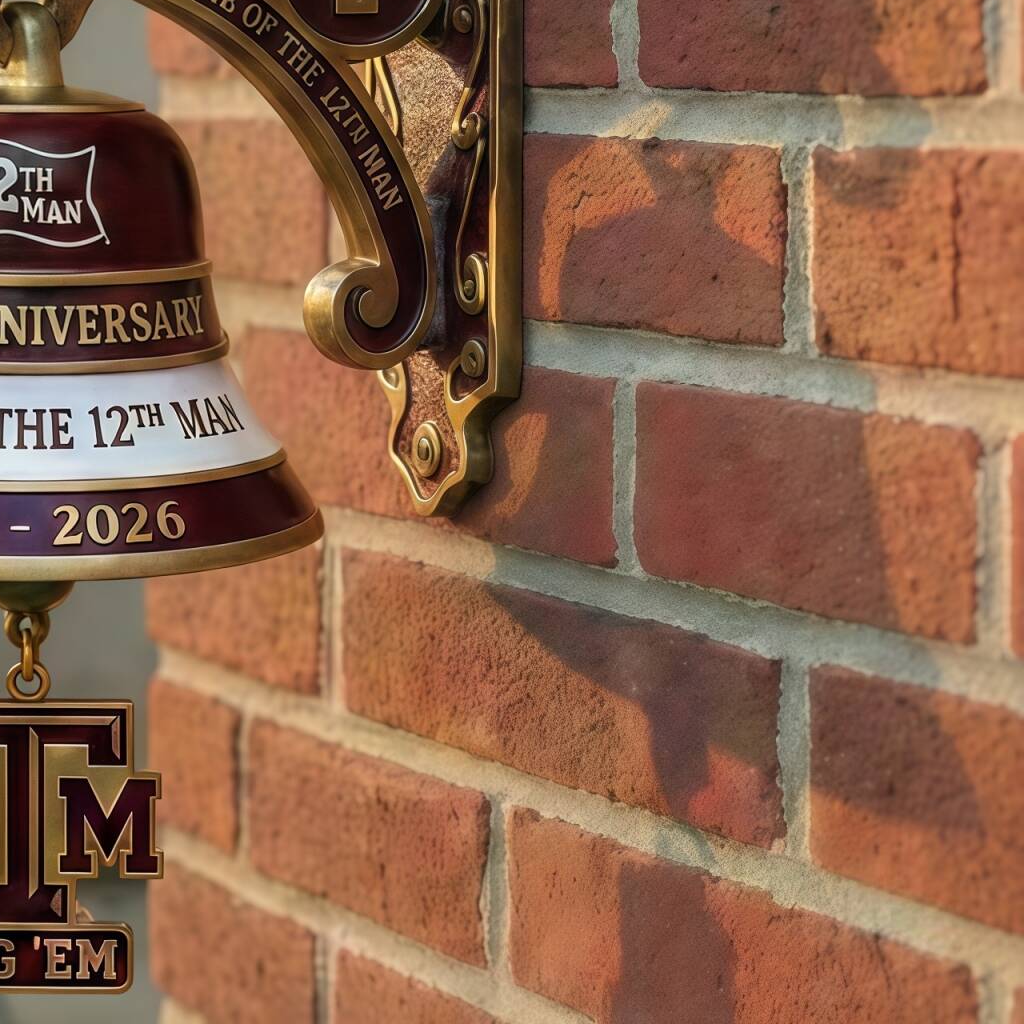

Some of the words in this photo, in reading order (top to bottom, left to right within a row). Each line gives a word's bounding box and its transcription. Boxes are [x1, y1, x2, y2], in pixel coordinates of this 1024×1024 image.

[242, 3, 279, 36] OF
[276, 30, 325, 87] THE
[22, 195, 83, 225] MAN
[88, 402, 166, 448] 12TH
[169, 393, 245, 440] MAN
[52, 500, 187, 547] 2026
[33, 935, 118, 980] 'EM
